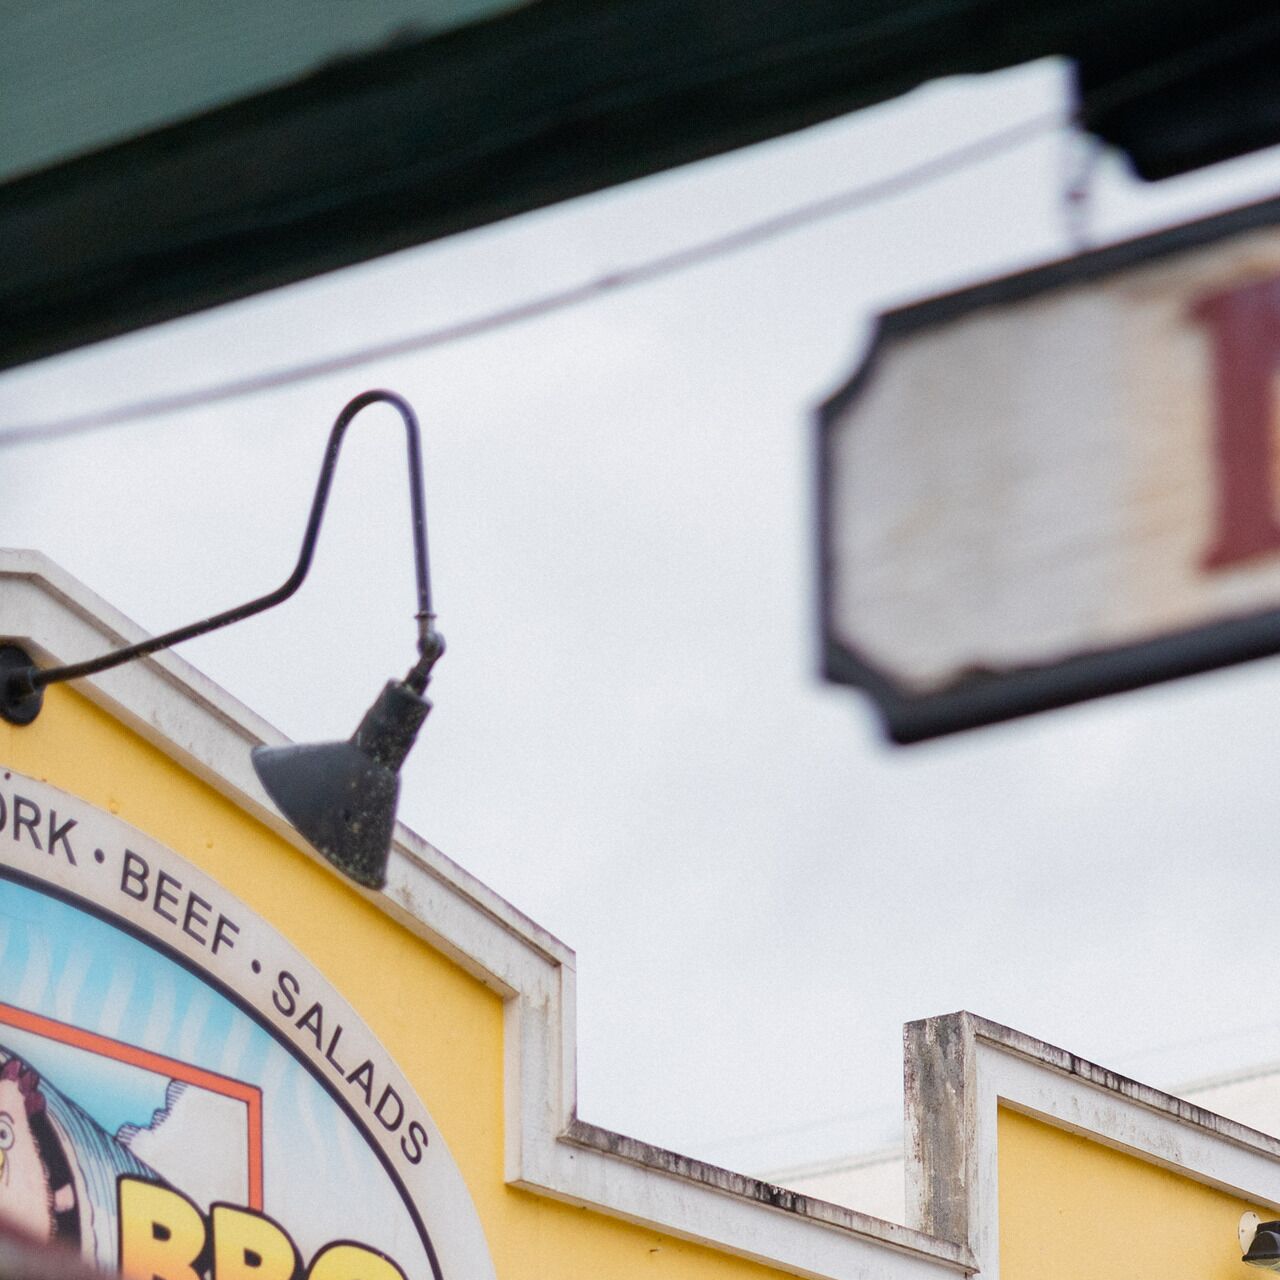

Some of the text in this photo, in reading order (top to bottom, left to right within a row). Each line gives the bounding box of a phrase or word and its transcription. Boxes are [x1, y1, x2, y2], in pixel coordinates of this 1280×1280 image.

[0, 791, 430, 1166] RK BEEF SALADS
